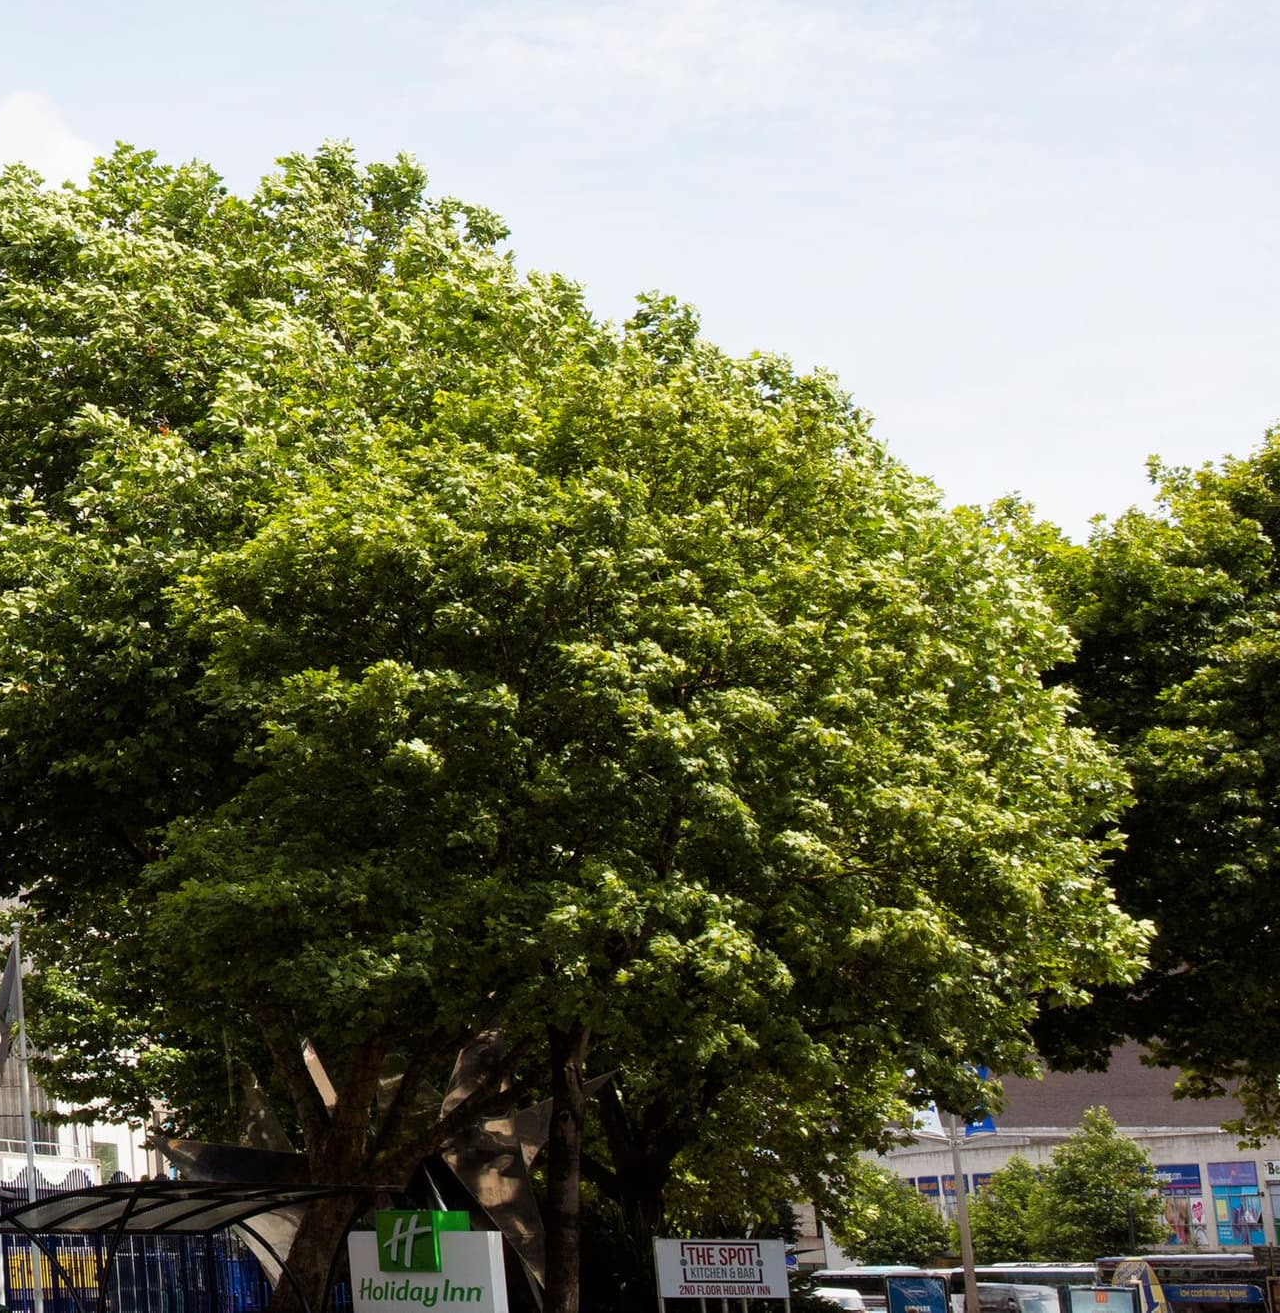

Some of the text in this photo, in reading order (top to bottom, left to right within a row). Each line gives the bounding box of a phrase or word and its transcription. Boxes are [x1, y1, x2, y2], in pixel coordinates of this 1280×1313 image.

[686, 1247, 755, 1266] THE SPOT
[690, 1267, 755, 1279] KITCHEN & BAR
[359, 1278, 482, 1307] Holiday Inn
[679, 1285, 771, 1296] 2ND FLOOR HOLIDAY INN
